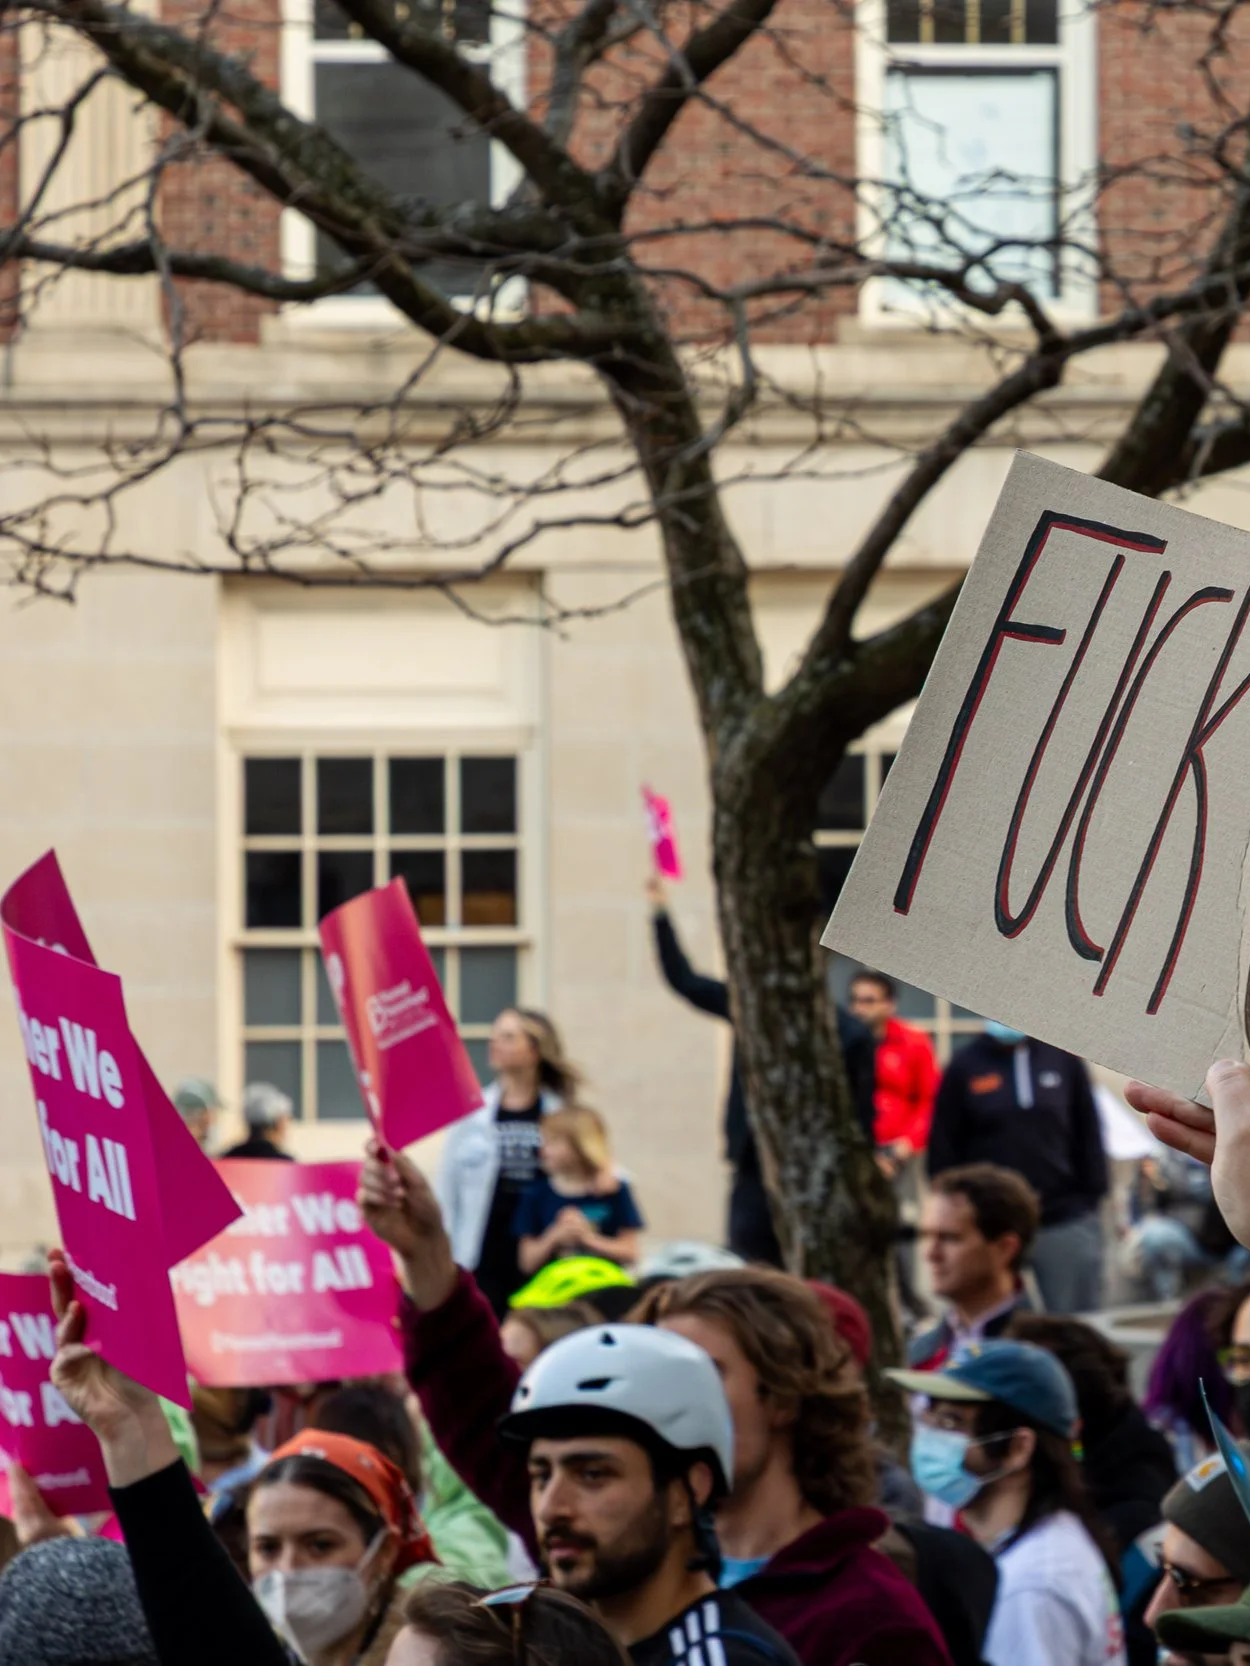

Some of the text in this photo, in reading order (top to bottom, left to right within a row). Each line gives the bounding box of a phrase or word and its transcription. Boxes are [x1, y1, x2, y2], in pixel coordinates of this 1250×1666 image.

[58, 1015, 126, 1110] We
[85, 1133, 137, 1221] All
[290, 1191, 363, 1234] We
[169, 1250, 249, 1307] ight
[249, 1250, 304, 1295] for
[312, 1244, 373, 1293] All
[8, 1311, 57, 1360] W
